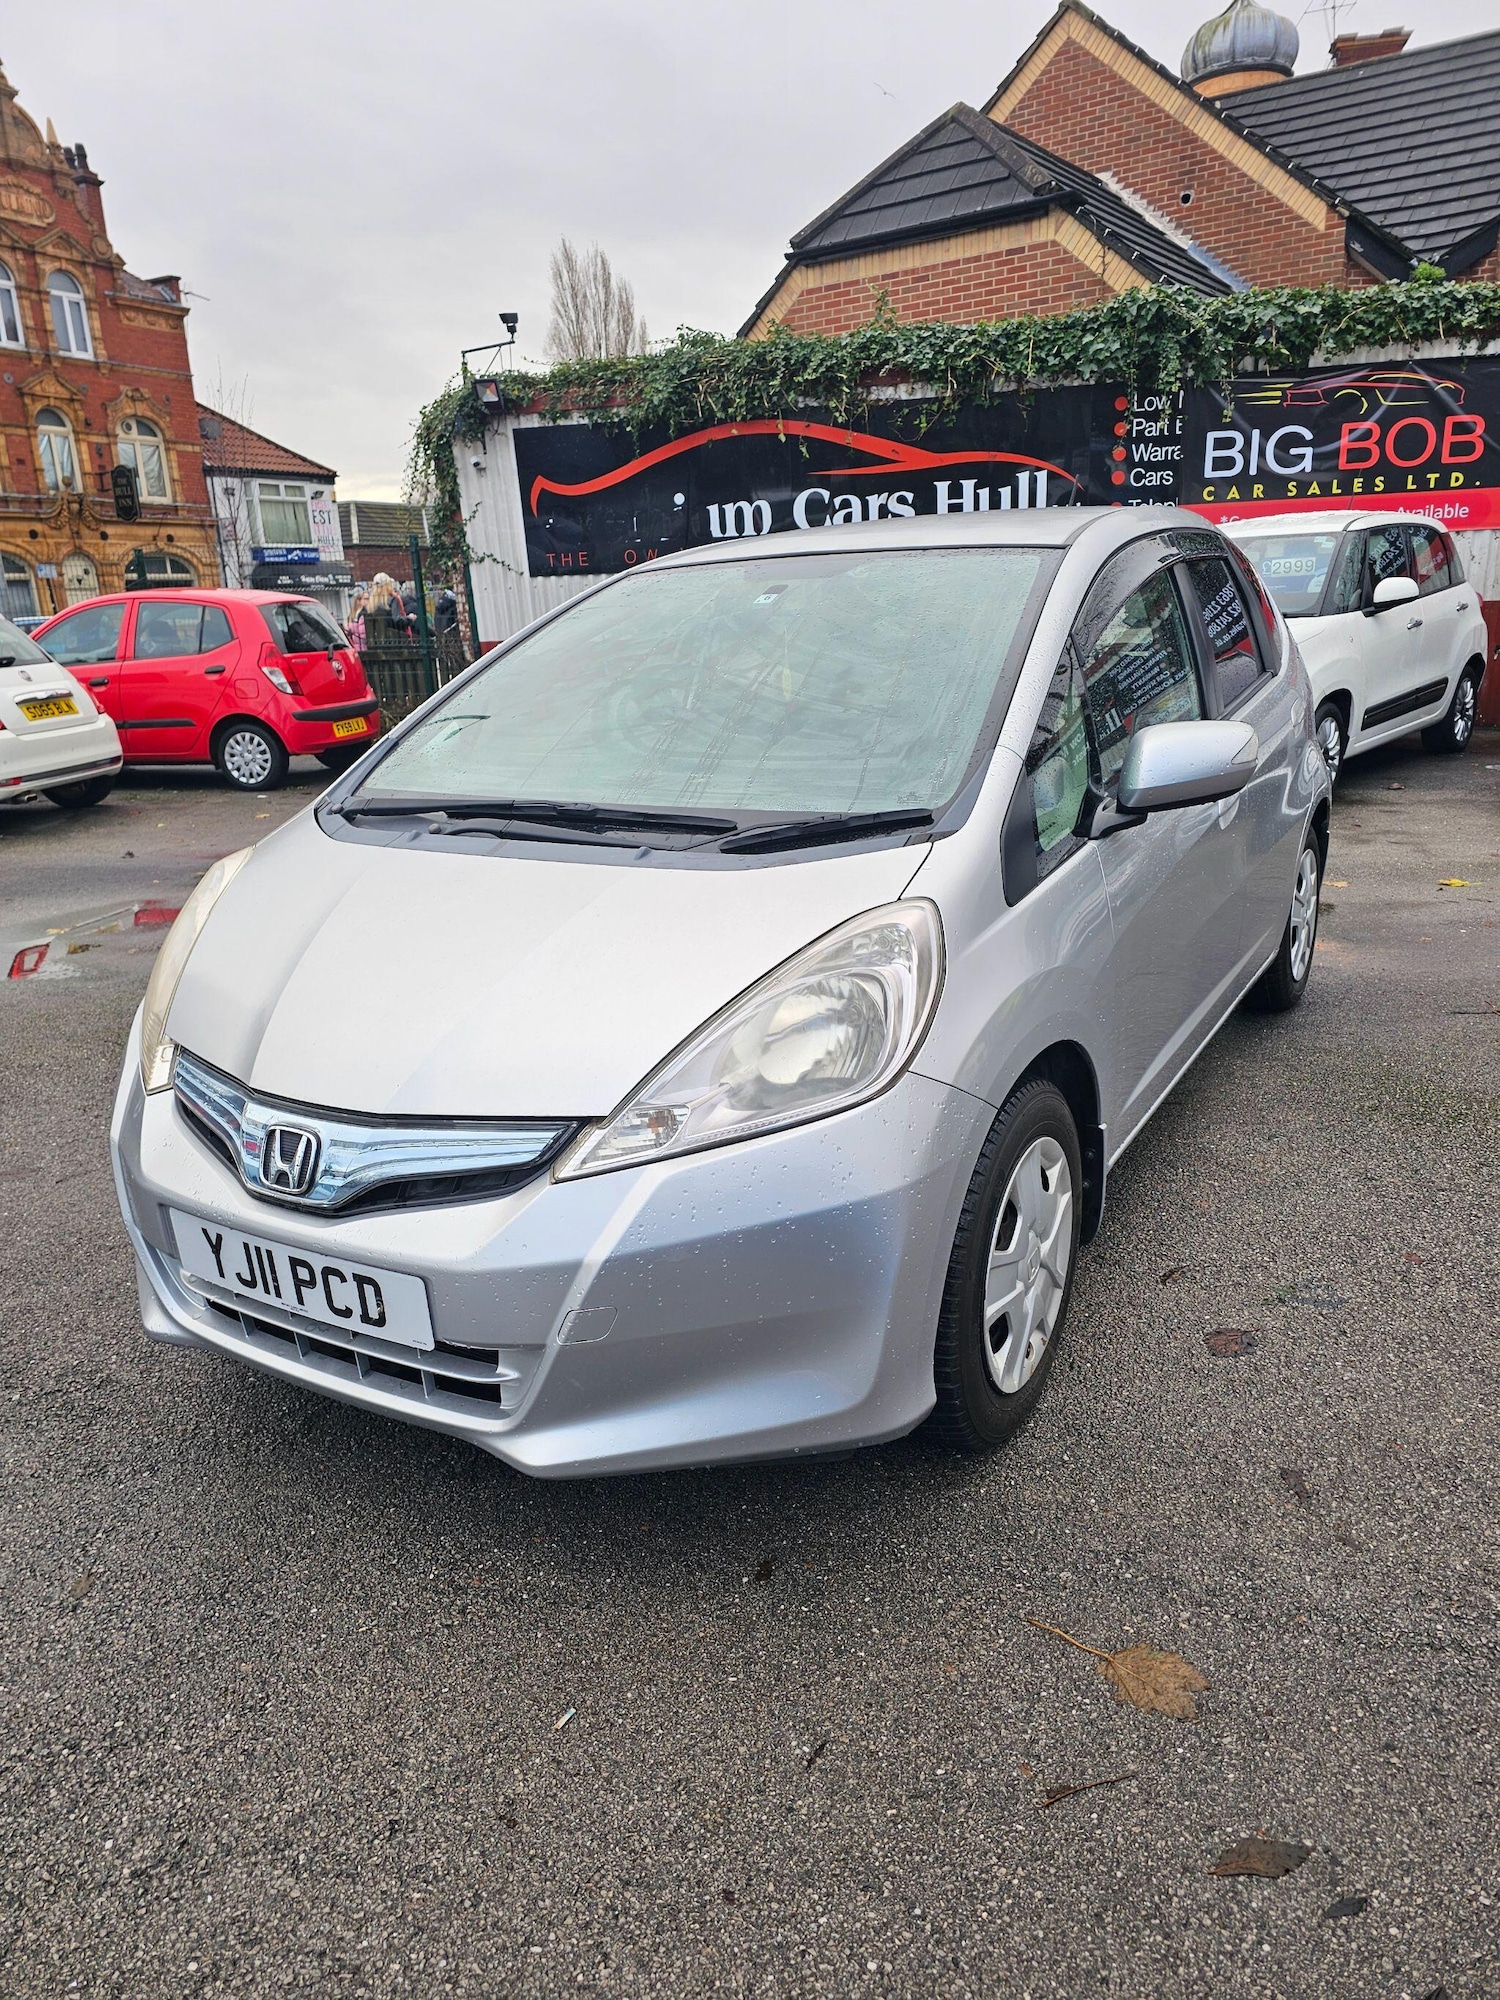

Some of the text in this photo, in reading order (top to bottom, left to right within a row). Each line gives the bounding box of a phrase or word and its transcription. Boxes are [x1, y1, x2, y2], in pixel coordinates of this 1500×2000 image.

[1132, 417, 1169, 438] Part
[1203, 413, 1486, 479] BIG BOB
[1130, 467, 1174, 487] Cars
[1202, 483, 1264, 501] CAR
[1287, 475, 1385, 497] SALES
[792, 487, 916, 530] Cars
[933, 469, 1047, 515] Hull
[1397, 501, 1469, 520] Available
[545, 551, 589, 567] THE
[287, 1255, 387, 1329] PCD
